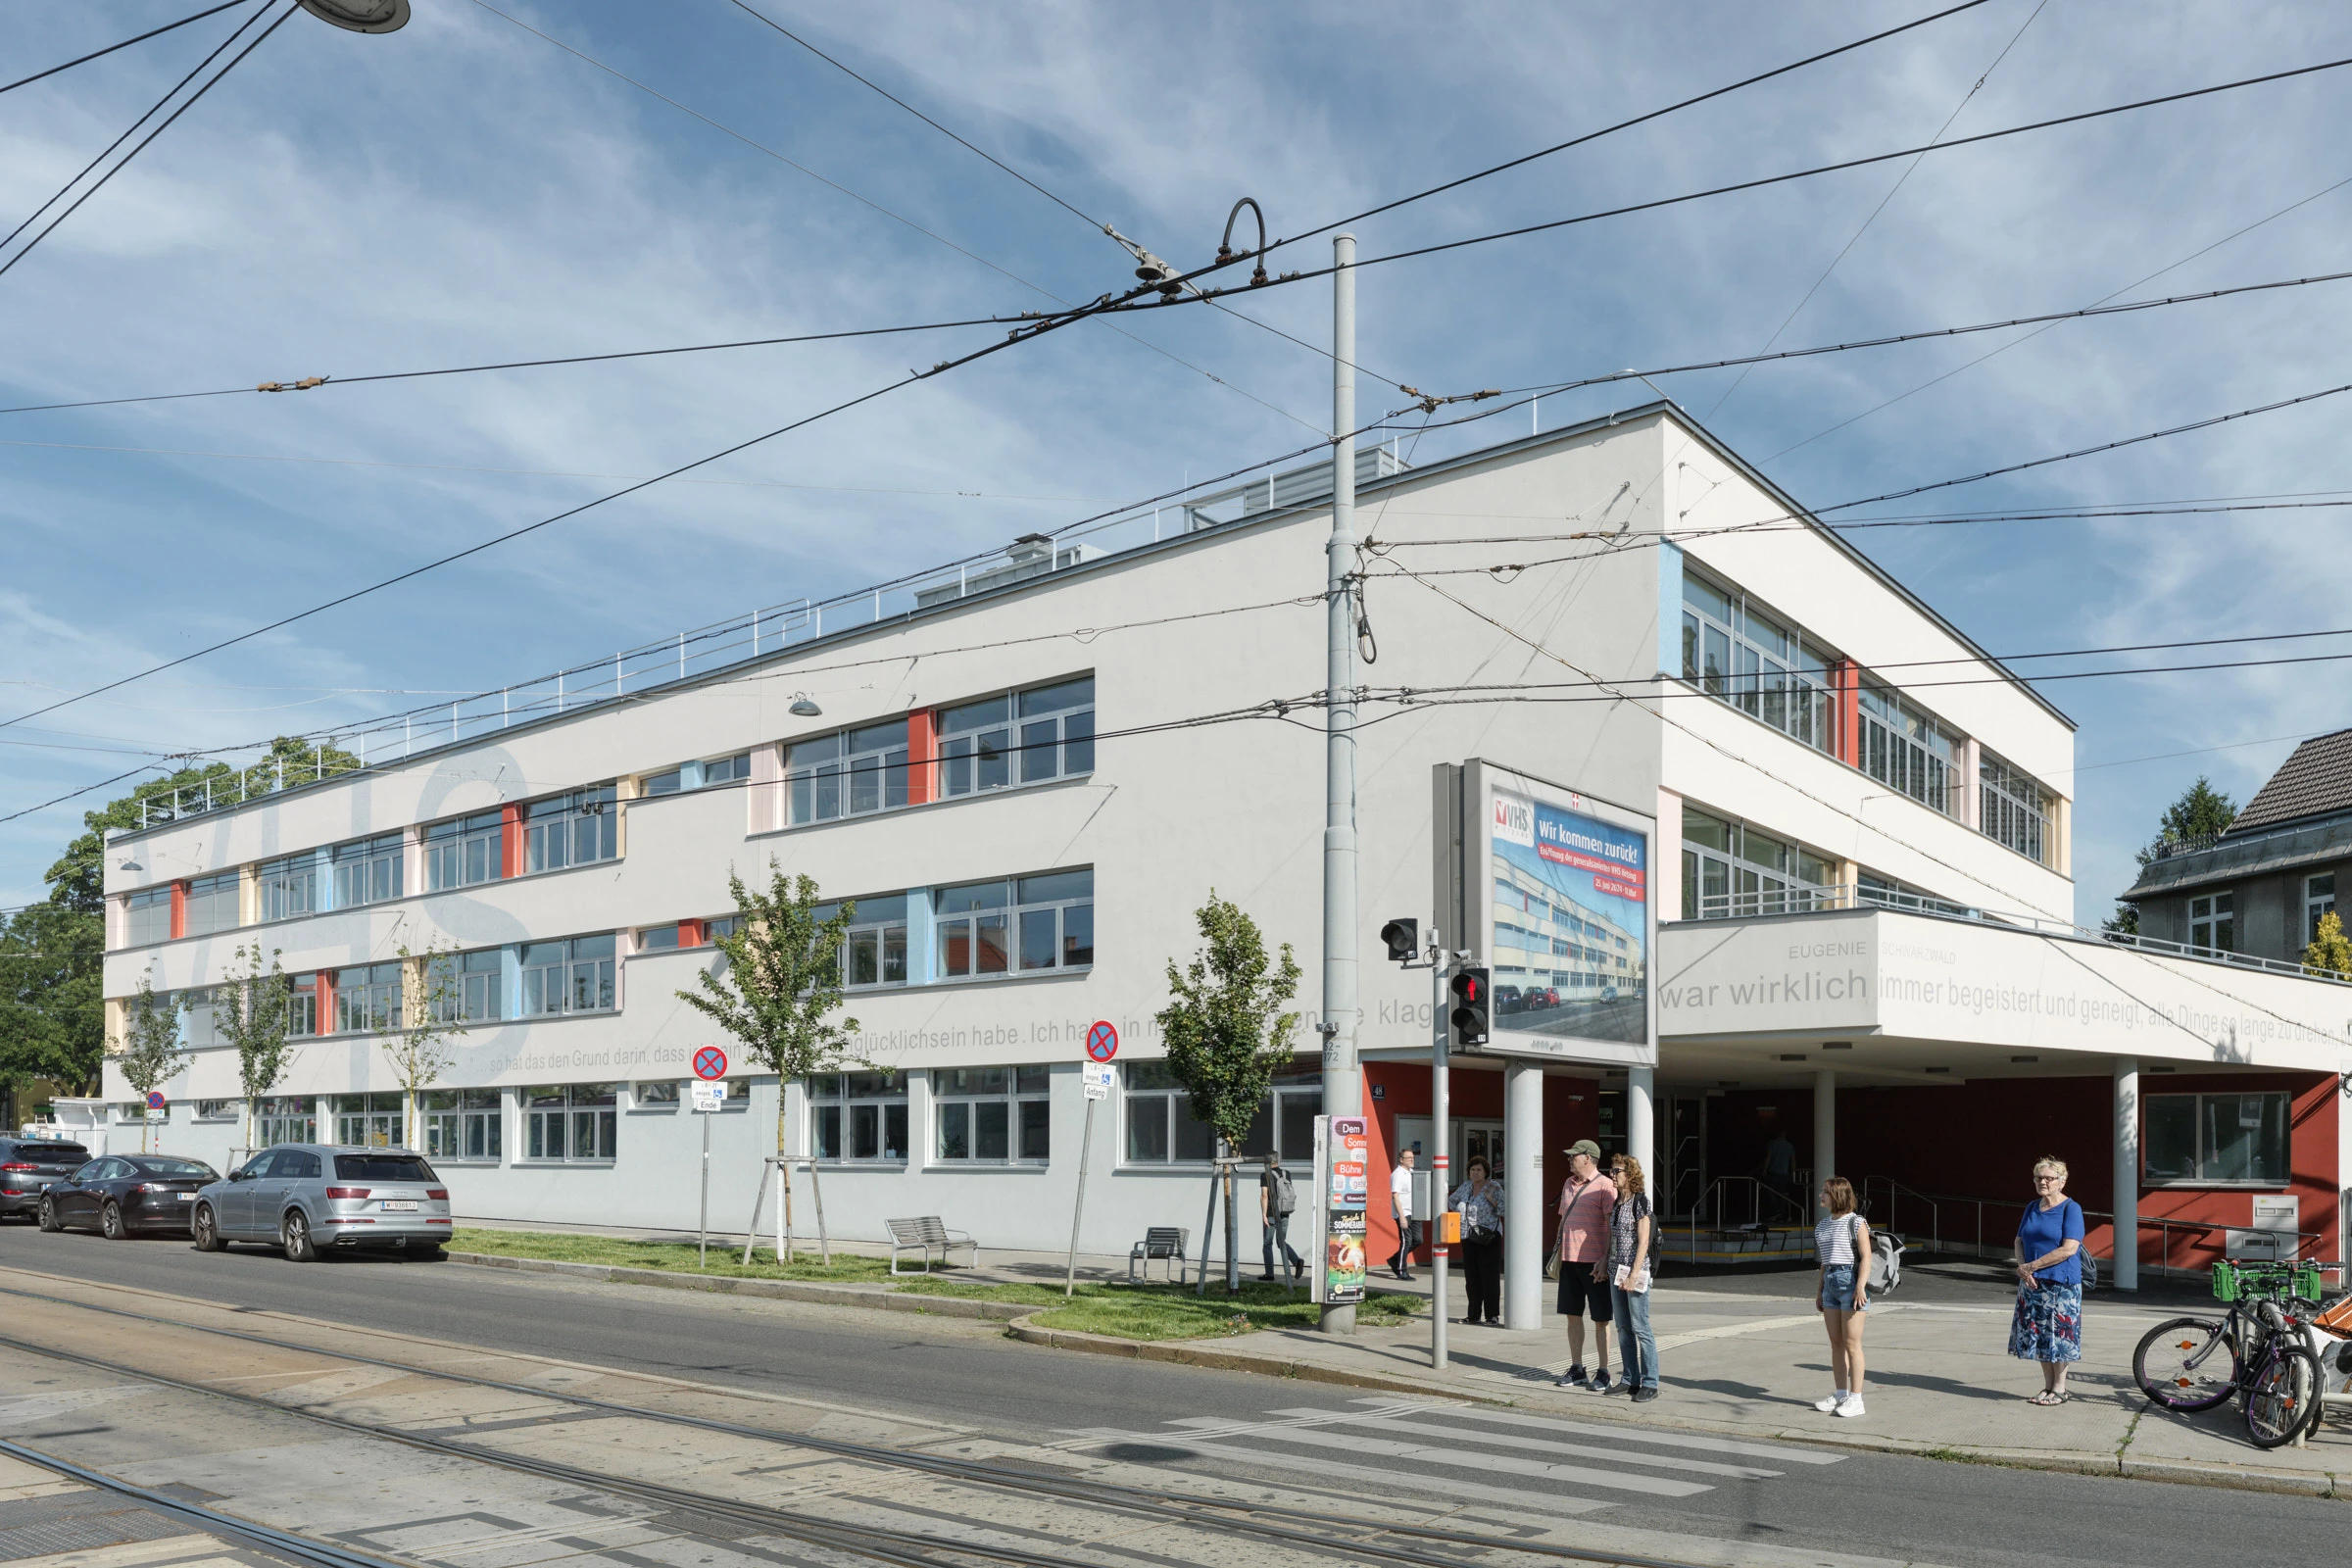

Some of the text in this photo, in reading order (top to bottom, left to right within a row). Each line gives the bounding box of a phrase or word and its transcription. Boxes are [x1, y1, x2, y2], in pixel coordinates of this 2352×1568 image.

[1507, 804, 1528, 832] VHS
[1539, 819, 1638, 864] Wir kommen zurück!
[1540, 846, 1564, 862] Eröffnung
[1564, 852, 1573, 862] der
[1611, 863, 1621, 875] VHS
[1610, 881, 1623, 893] 2024
[1788, 941, 1956, 965] EUGENIE SCHWARZWALD
[490, 1059, 503, 1072] so
[505, 1054, 523, 1071] hat
[525, 1053, 546, 1069] das
[548, 1052, 569, 1068] den
[571, 1048, 610, 1067] Grund
[613, 1046, 651, 1065] darin,
[654, 1044, 685, 1063] dass
[841, 1027, 966, 1057] nglücklichsein
[1030, 1021, 1059, 1044] Ich
[1122, 1016, 1140, 1039] in
[1379, 999, 1433, 1029] klag
[1659, 984, 1720, 1008] war
[1729, 969, 1867, 1005] wirklich
[1880, 968, 1943, 1004] immer
[1948, 977, 2042, 1015] begeistert
[2045, 992, 2076, 1017] und
[2081, 997, 2144, 1030] geneigt,
[2148, 1002, 2175, 1027] alle
[2179, 1004, 2218, 1038] Dinge
[2221, 1015, 2237, 1033] so
[2240, 1011, 2275, 1044] lange
[2278, 1021, 2292, 1041] zu
[1086, 1087, 1105, 1099] Anfang
[1375, 1086, 1383, 1096] 48
[1343, 1123, 1360, 1133] Dem
[1340, 1164, 1362, 1174] Bühne
